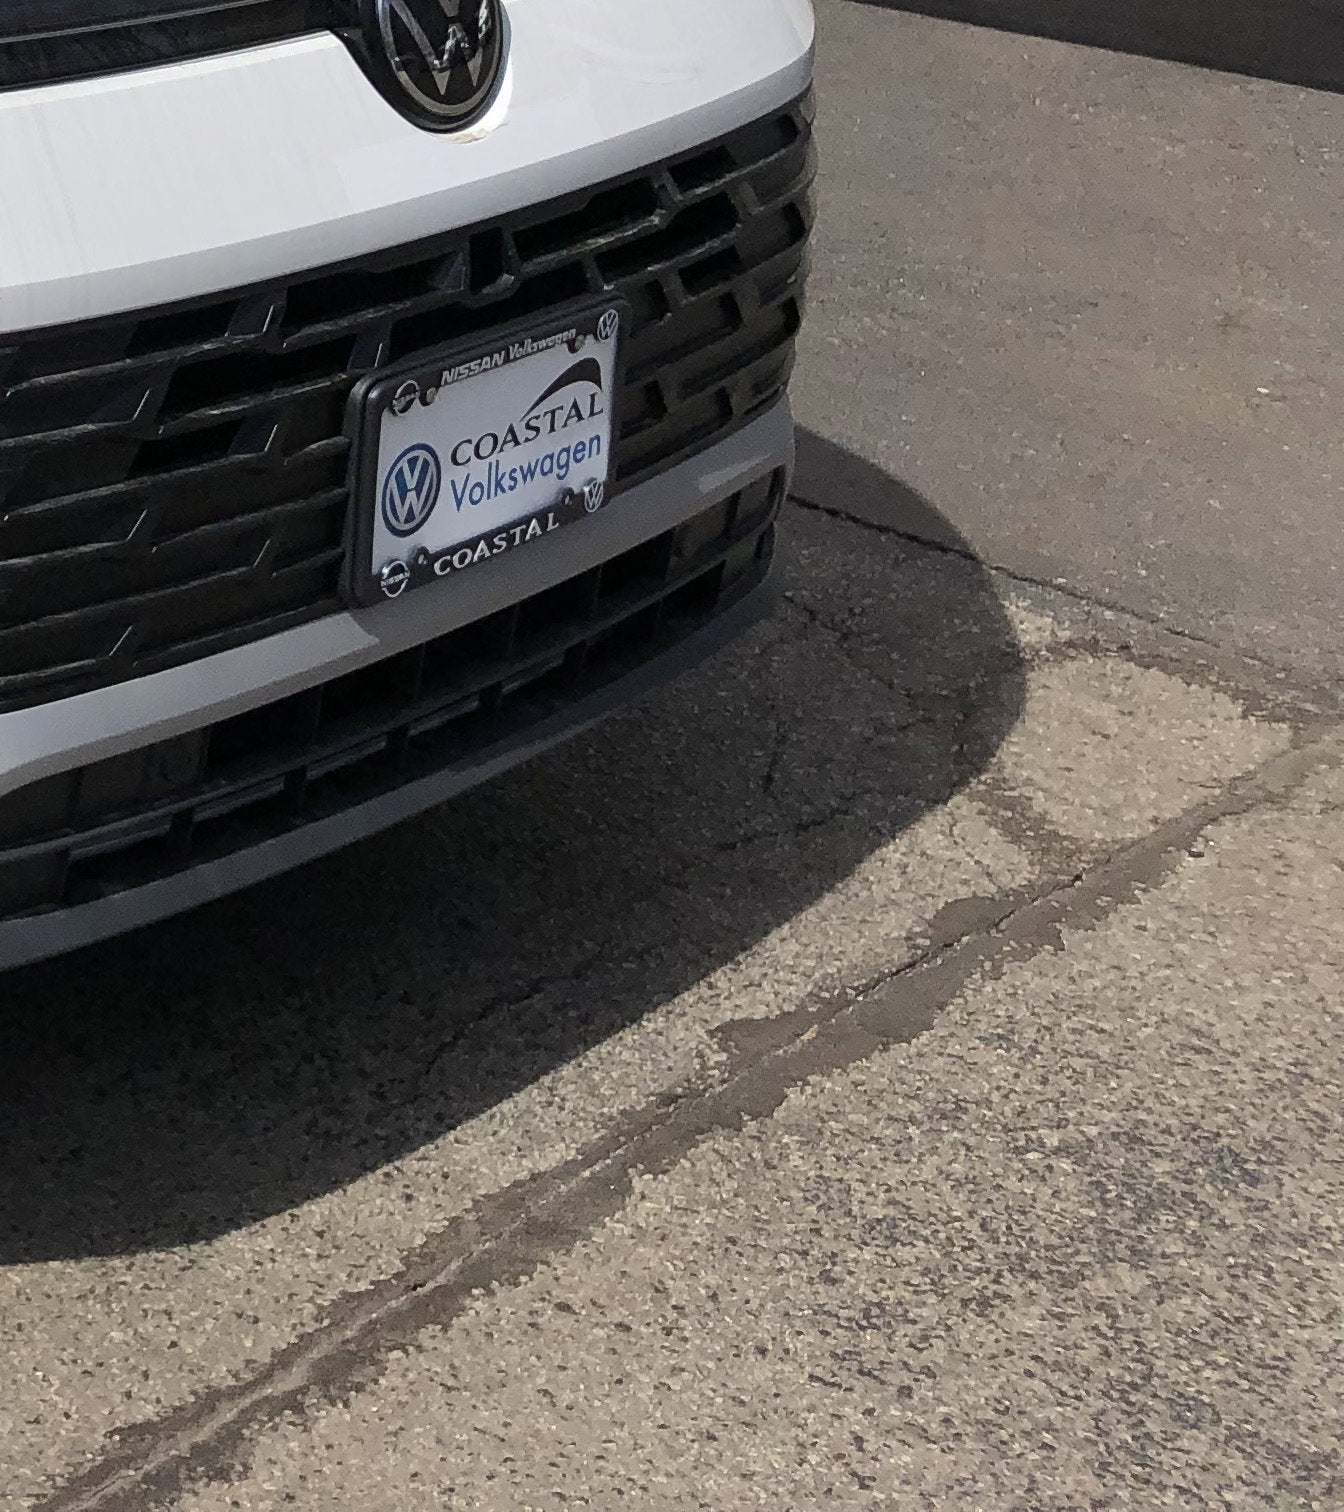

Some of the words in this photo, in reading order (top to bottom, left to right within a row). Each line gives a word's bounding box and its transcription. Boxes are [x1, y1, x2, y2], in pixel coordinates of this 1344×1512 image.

[441, 350, 505, 386] NISSAN
[508, 328, 576, 360] Volkswagen
[451, 393, 604, 467] COASTAL
[451, 434, 602, 513] Volkswagen
[434, 512, 560, 577] COASTAL
